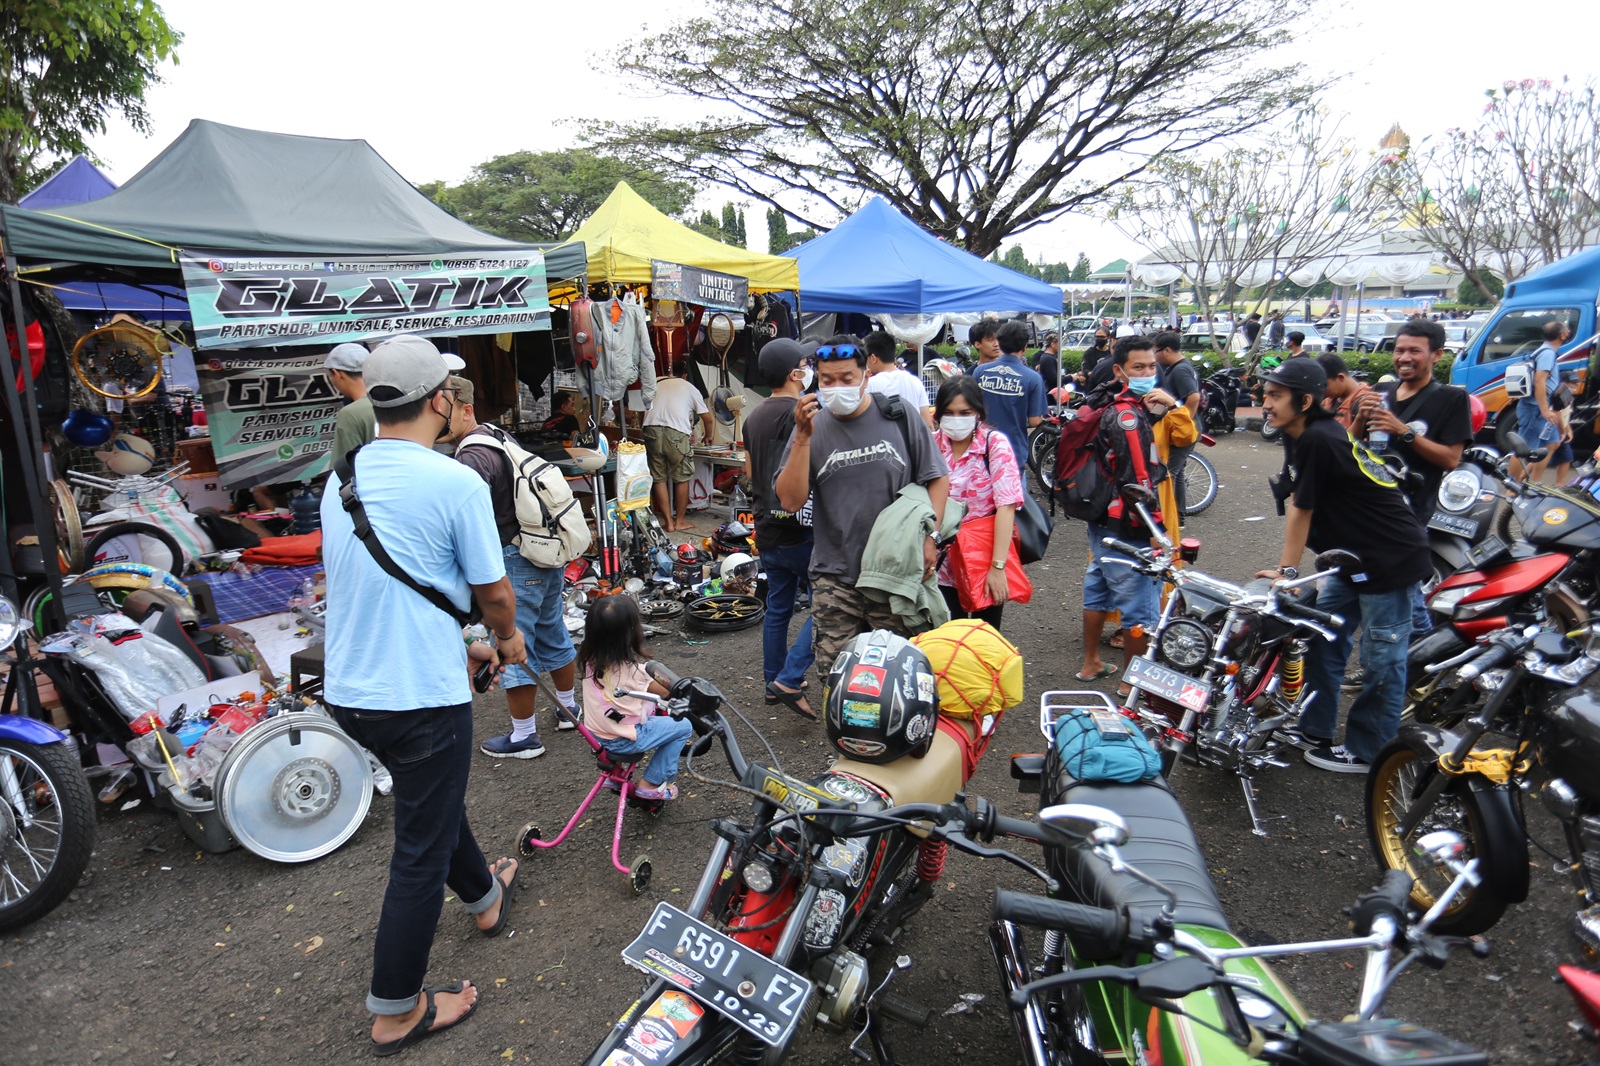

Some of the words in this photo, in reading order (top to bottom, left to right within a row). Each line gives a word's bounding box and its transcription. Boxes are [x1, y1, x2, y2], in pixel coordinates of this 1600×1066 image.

[701, 273, 733, 290] UNITED
[213, 275, 533, 318] GLATIK
[699, 285, 736, 303] VINTAGE
[454, 312, 536, 326] RESTORATION
[996, 377, 1023, 393] Dutch
[816, 439, 907, 480] METALLICA
[1130, 659, 1141, 672] B
[1143, 665, 1178, 687] 4573
[647, 909, 672, 936] F
[677, 926, 740, 977] 6591
[763, 973, 803, 1016] FZ
